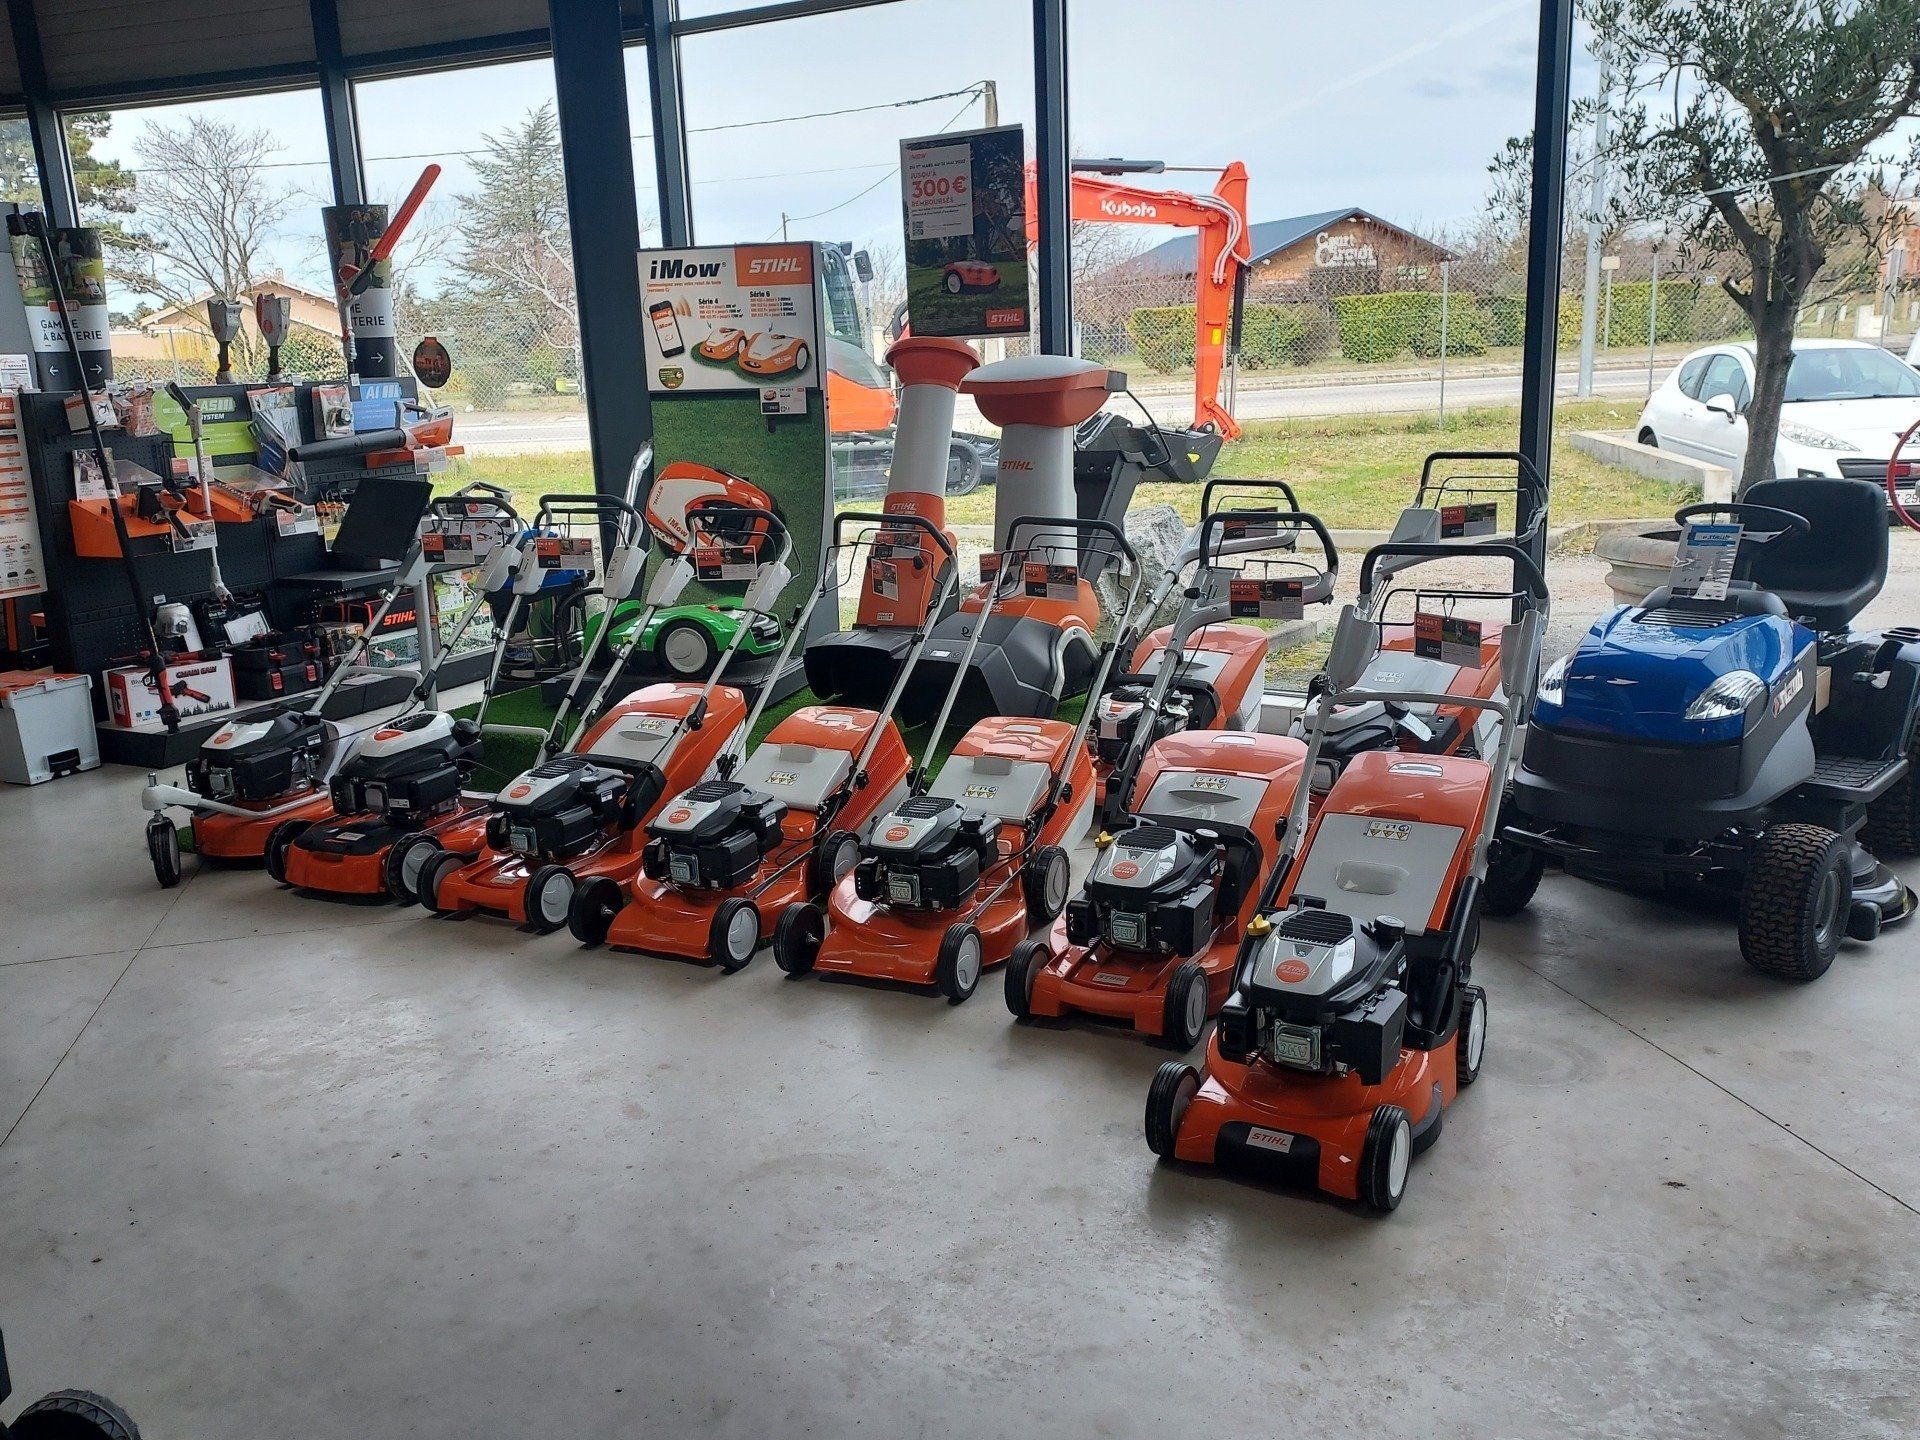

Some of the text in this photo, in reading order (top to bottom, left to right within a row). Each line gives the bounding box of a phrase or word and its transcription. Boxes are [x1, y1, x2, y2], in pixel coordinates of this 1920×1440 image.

[912, 177, 950, 198] 300
[911, 196, 954, 207] REMBOURSÉS
[1100, 199, 1157, 218] Kubota
[749, 257, 802, 274] STIHL
[749, 290, 765, 298] Série
[41, 319, 79, 329] GAME
[990, 313, 1021, 323] STIHL
[43, 329, 103, 342] À BAERIE
[1002, 460, 1034, 471] STIHL
[654, 484, 663, 505] STIHL
[890, 502, 917, 511] STIHL
[383, 610, 416, 626] STIHL
[1097, 973, 1127, 983] STIHL
[1278, 1041, 1308, 1058] OHV
[1251, 1131, 1288, 1147] STIHL
